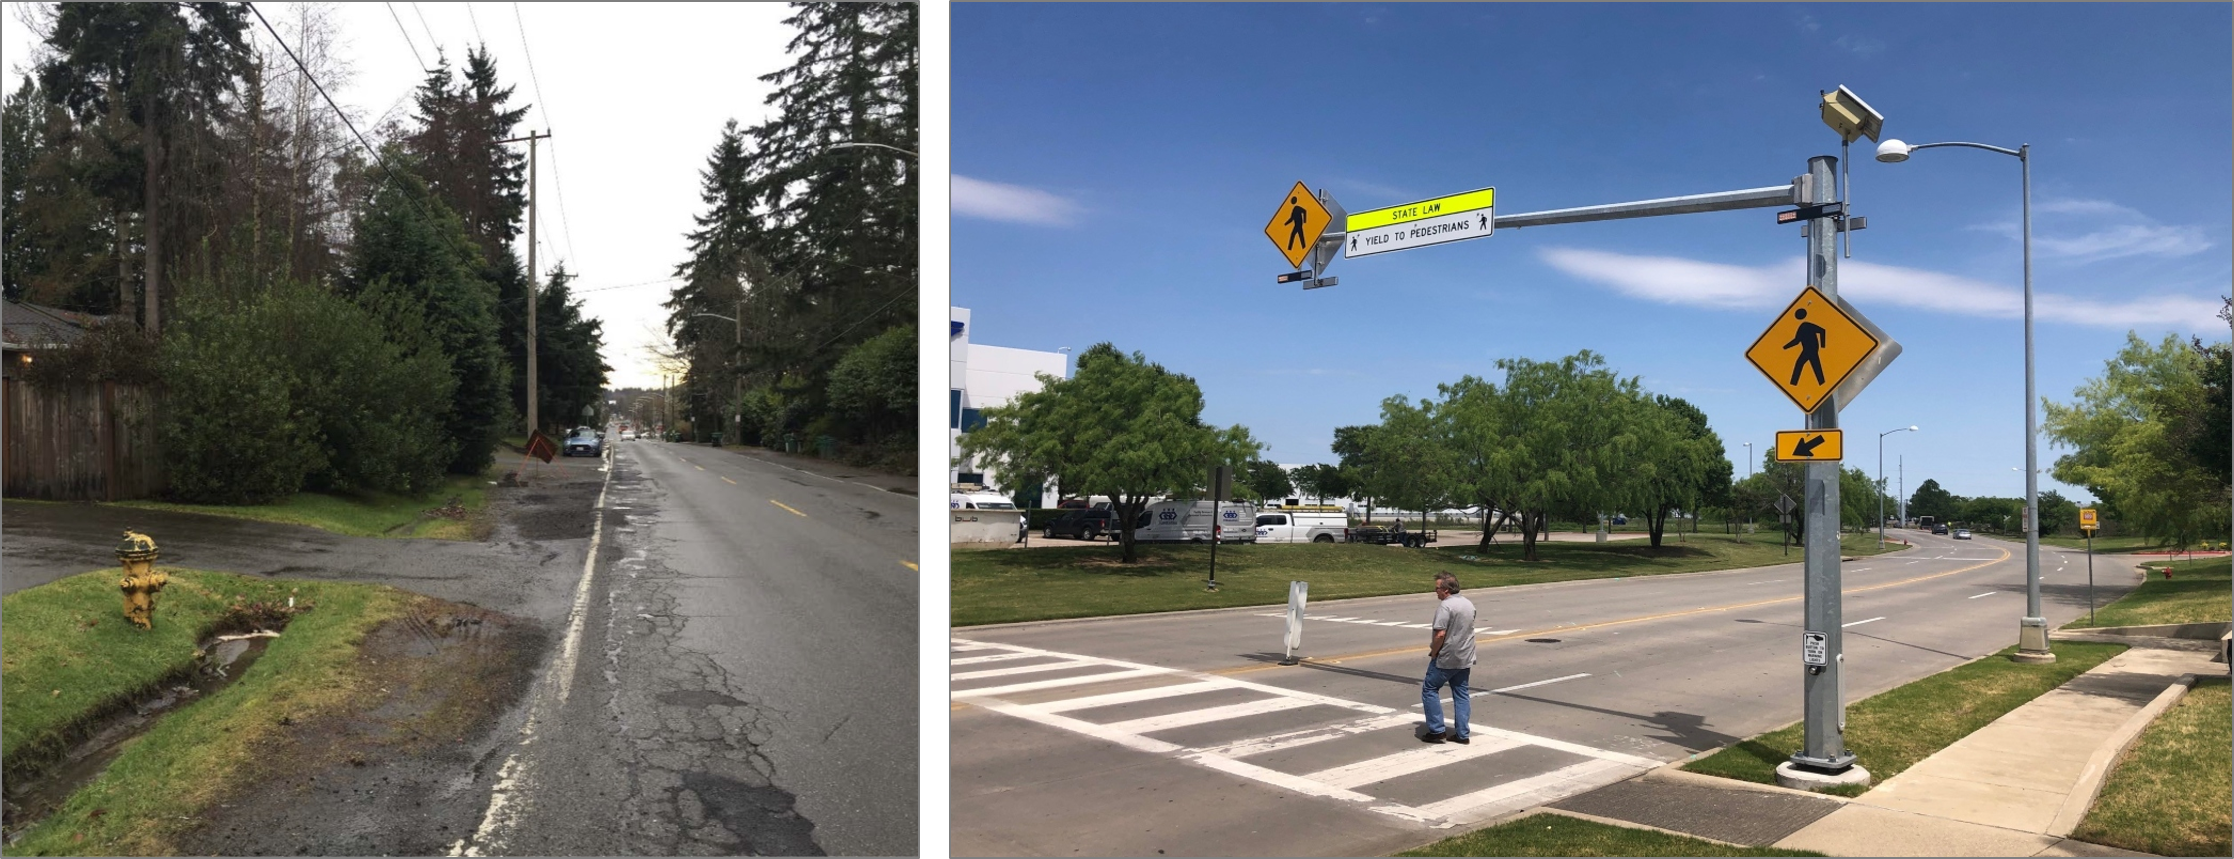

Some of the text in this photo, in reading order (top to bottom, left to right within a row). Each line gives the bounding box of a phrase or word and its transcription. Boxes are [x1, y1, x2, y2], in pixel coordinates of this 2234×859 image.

[1392, 203, 1441, 220] STATE LAW
[1365, 220, 1470, 246] YIELD TO PEDESTRIANS
